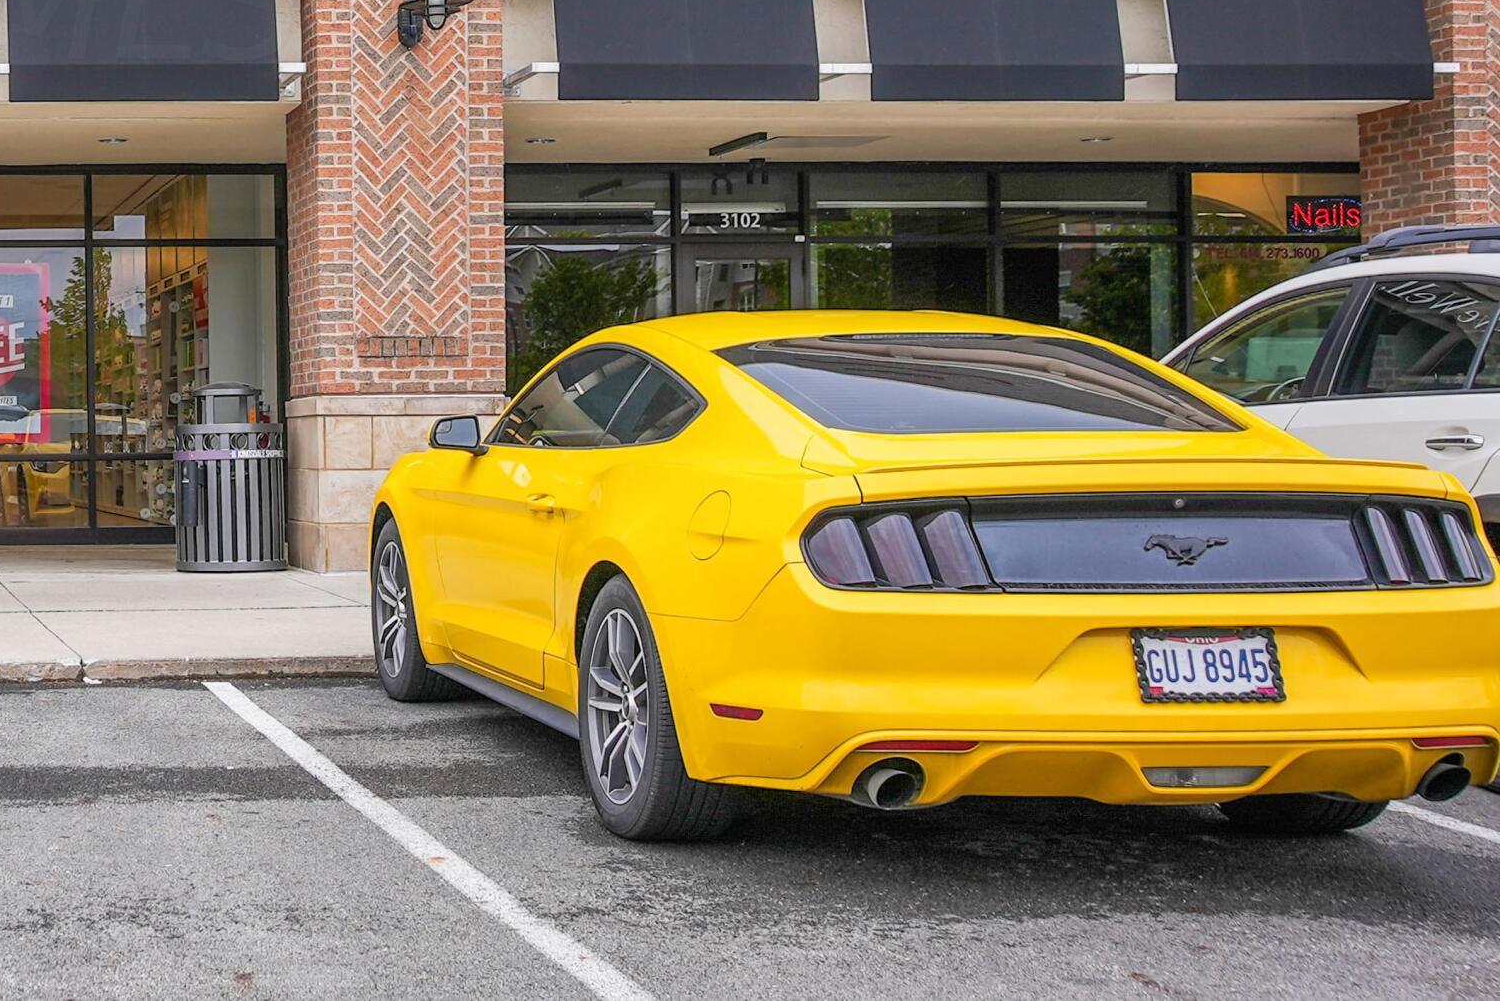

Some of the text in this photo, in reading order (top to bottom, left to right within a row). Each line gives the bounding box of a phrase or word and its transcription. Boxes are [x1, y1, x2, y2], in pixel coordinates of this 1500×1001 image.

[720, 213, 761, 228] 3102
[1293, 201, 1361, 228] Nails
[7, 297, 11, 306] 1
[1147, 648, 1269, 683] GUJ 8945
